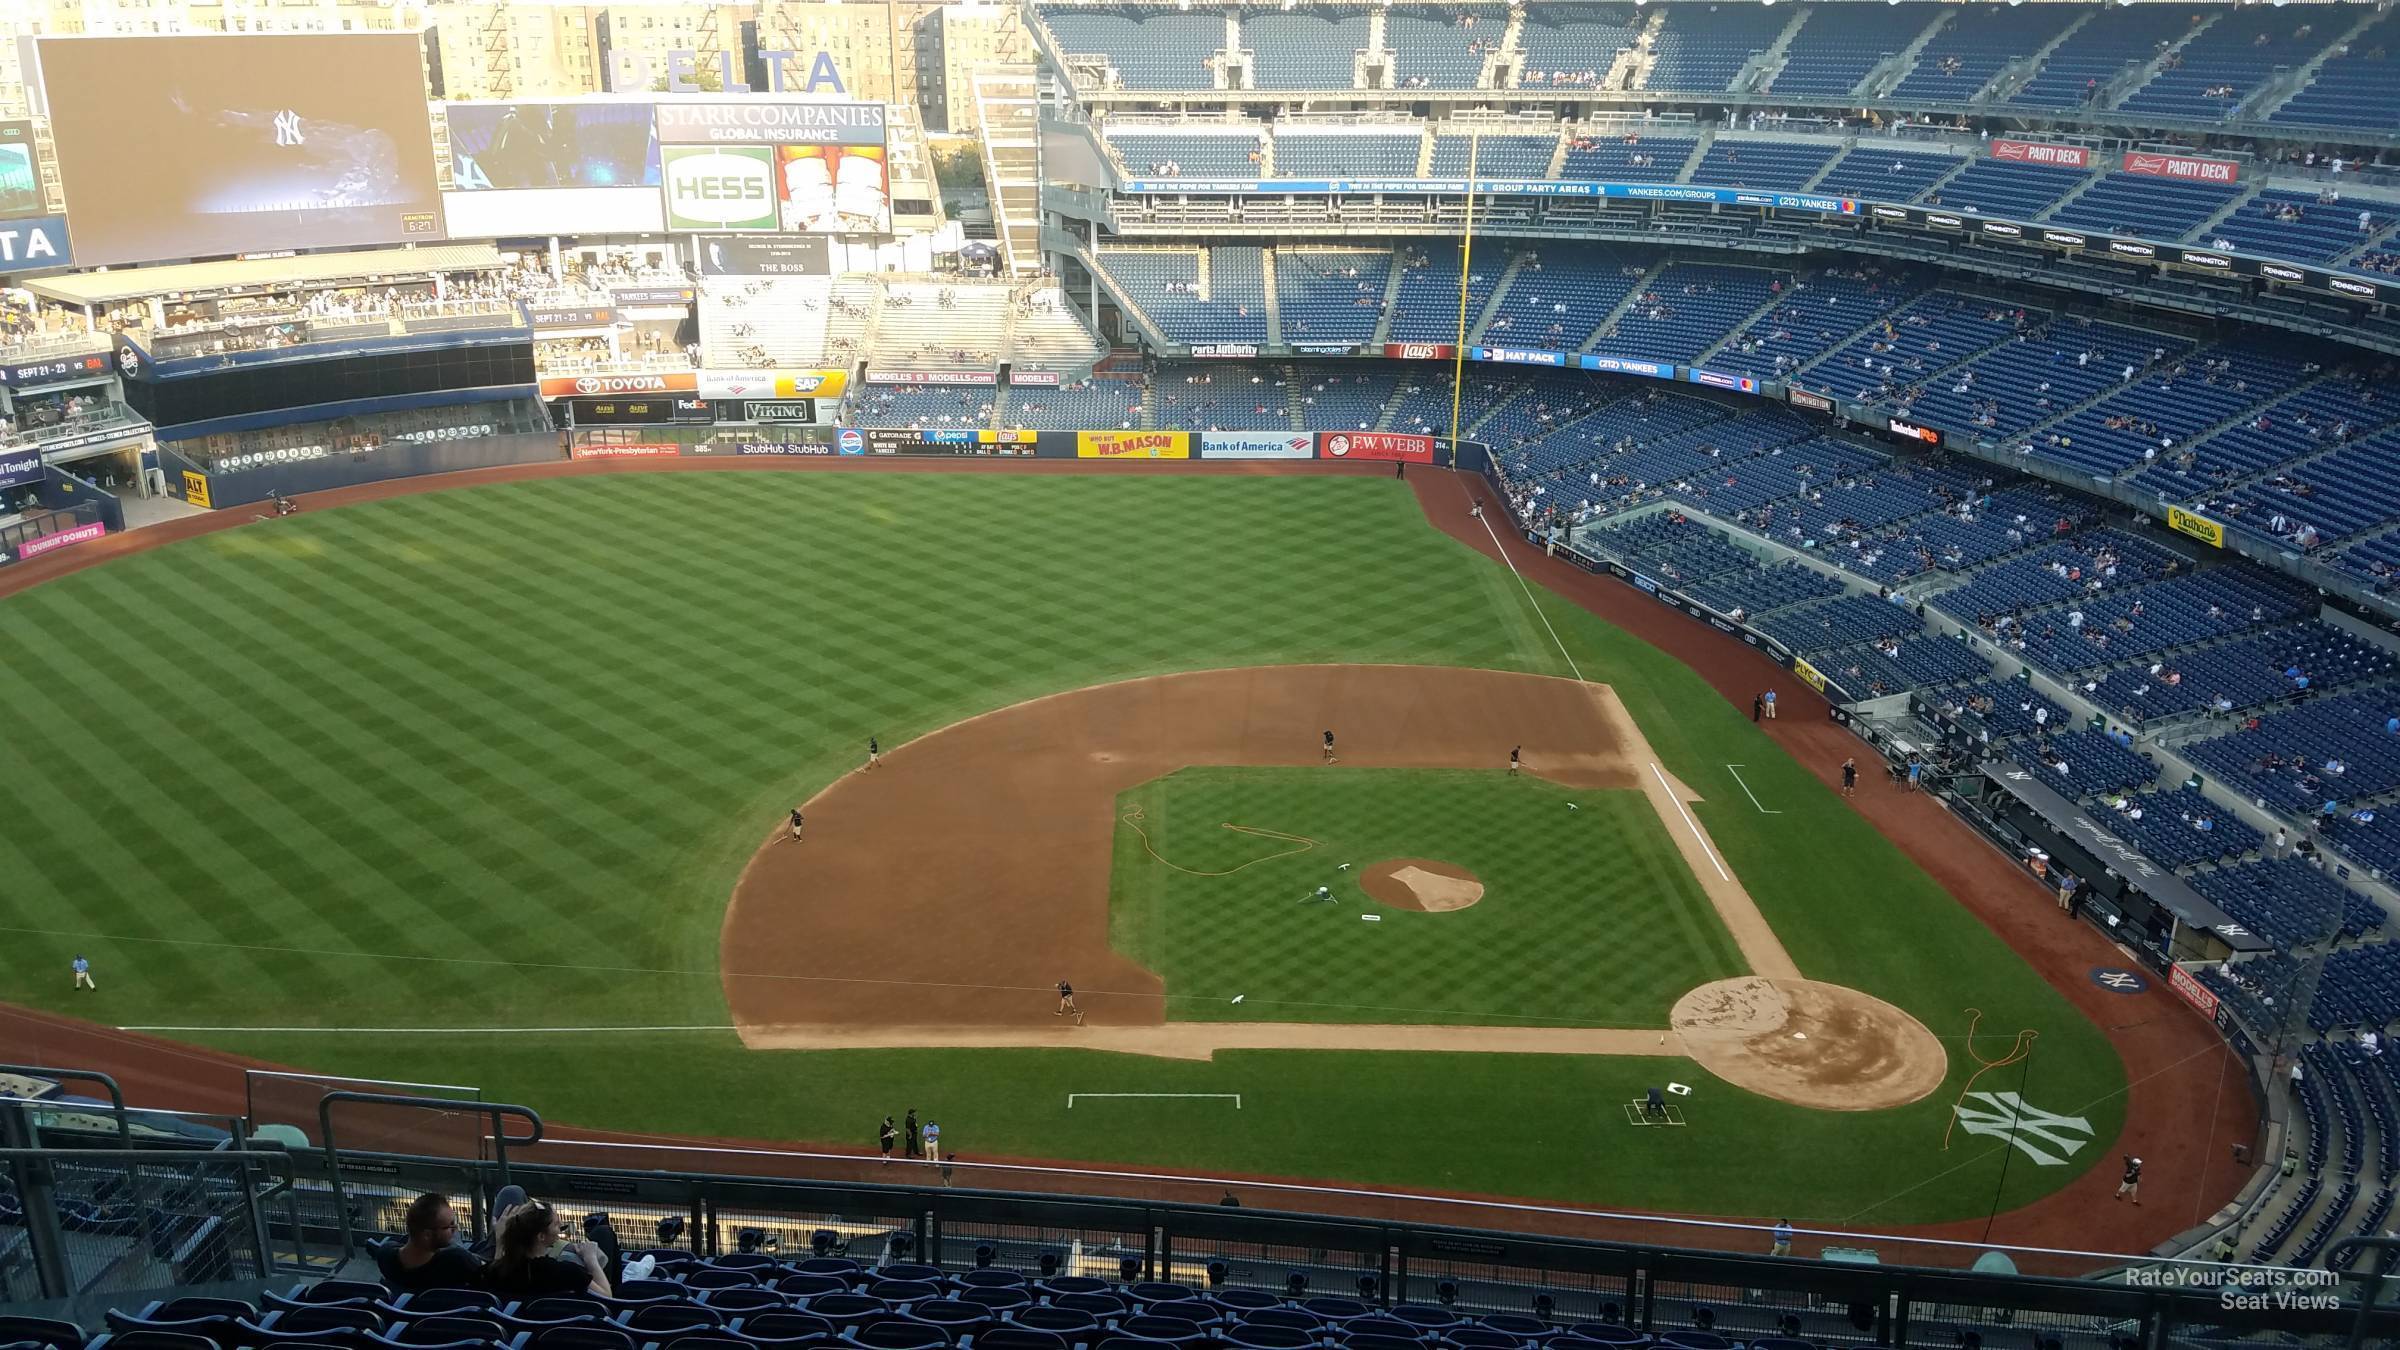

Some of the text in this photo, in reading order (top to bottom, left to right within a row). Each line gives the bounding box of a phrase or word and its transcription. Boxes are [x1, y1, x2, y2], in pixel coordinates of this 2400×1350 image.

[609, 50, 846, 93] DELTA
[661, 107, 882, 126] STARR COMPANIES
[710, 128, 838, 141] GLOBAL INSURANCE
[2028, 146, 2056, 161] PARTY
[2056, 149, 2081, 164] DECK
[2167, 160, 2200, 177] PARTY
[2200, 163, 2231, 180] DECK
[676, 176, 764, 199] HESS
[1558, 186, 1590, 194] AREAS
[1627, 187, 1716, 199] YANKEES.COM/GROUPS
[1779, 197, 1837, 210] (212) YANKEES
[1874, 208, 1906, 217] PENNINGTON
[409, 222, 431, 231] 6:27
[1928, 215, 1961, 226] PENNINGTON
[1985, 224, 2019, 234] PENNINGTON
[2046, 233, 2083, 244] PENNINGTON
[2112, 242, 2152, 255] PENNINGTON
[2184, 254, 2229, 267] PENNINGTON
[760, 263, 804, 272] THE BOSS
[2263, 266, 2302, 280] PENNINGTON
[2331, 280, 2374, 295] PENNINGTON
[536, 314, 552, 323] SEPT
[553, 313, 562, 322] 21
[568, 313, 577, 322] 23
[1191, 344, 1258, 355] Parts Authority
[1402, 344, 1435, 358] Lay's
[1506, 351, 1555, 363] HAT PACK
[17, 366, 40, 379] SEPT
[40, 365, 49, 376] 21
[55, 363, 66, 374] 23
[1599, 359, 1658, 374] (212) YANKEES
[601, 376, 666, 390] TOYOTA
[796, 377, 821, 391] SAP
[870, 373, 992, 382] MODELL'S MODELLS.com
[1014, 374, 1054, 383] MODELL'S
[678, 400, 708, 409] FedEx
[748, 403, 804, 418] VIKING
[869, 431, 877, 439] G
[914, 432, 921, 440] G
[945, 431, 968, 440] pepsi
[743, 444, 829, 454] StubHub StubHub
[1203, 441, 1283, 451] Bank of America
[1352, 436, 1426, 453] F.W. WEBB
[1434, 441, 1446, 450] 314
[0, 458, 39, 475] lTonight
[2174, 509, 2216, 538] Nathan's
[31, 527, 98, 553] DUNKIN' DONUTS
[2172, 968, 2213, 1008] MODELL'S
